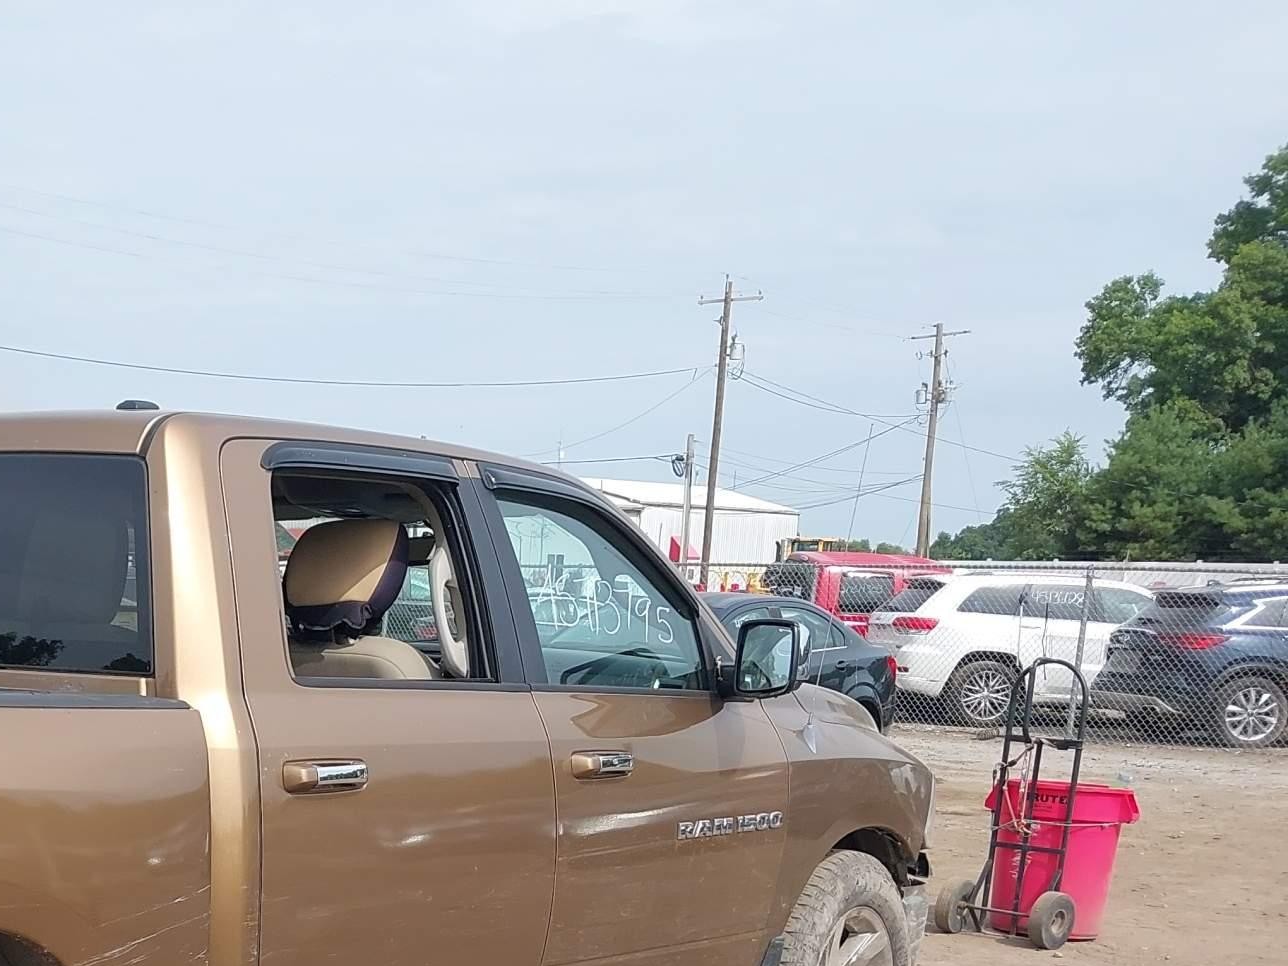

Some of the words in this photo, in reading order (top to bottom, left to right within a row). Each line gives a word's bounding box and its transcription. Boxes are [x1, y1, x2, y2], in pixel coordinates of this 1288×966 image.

[537, 564, 673, 643] 45713795
[677, 817, 733, 839] RAM
[737, 811, 783, 832] 1500
